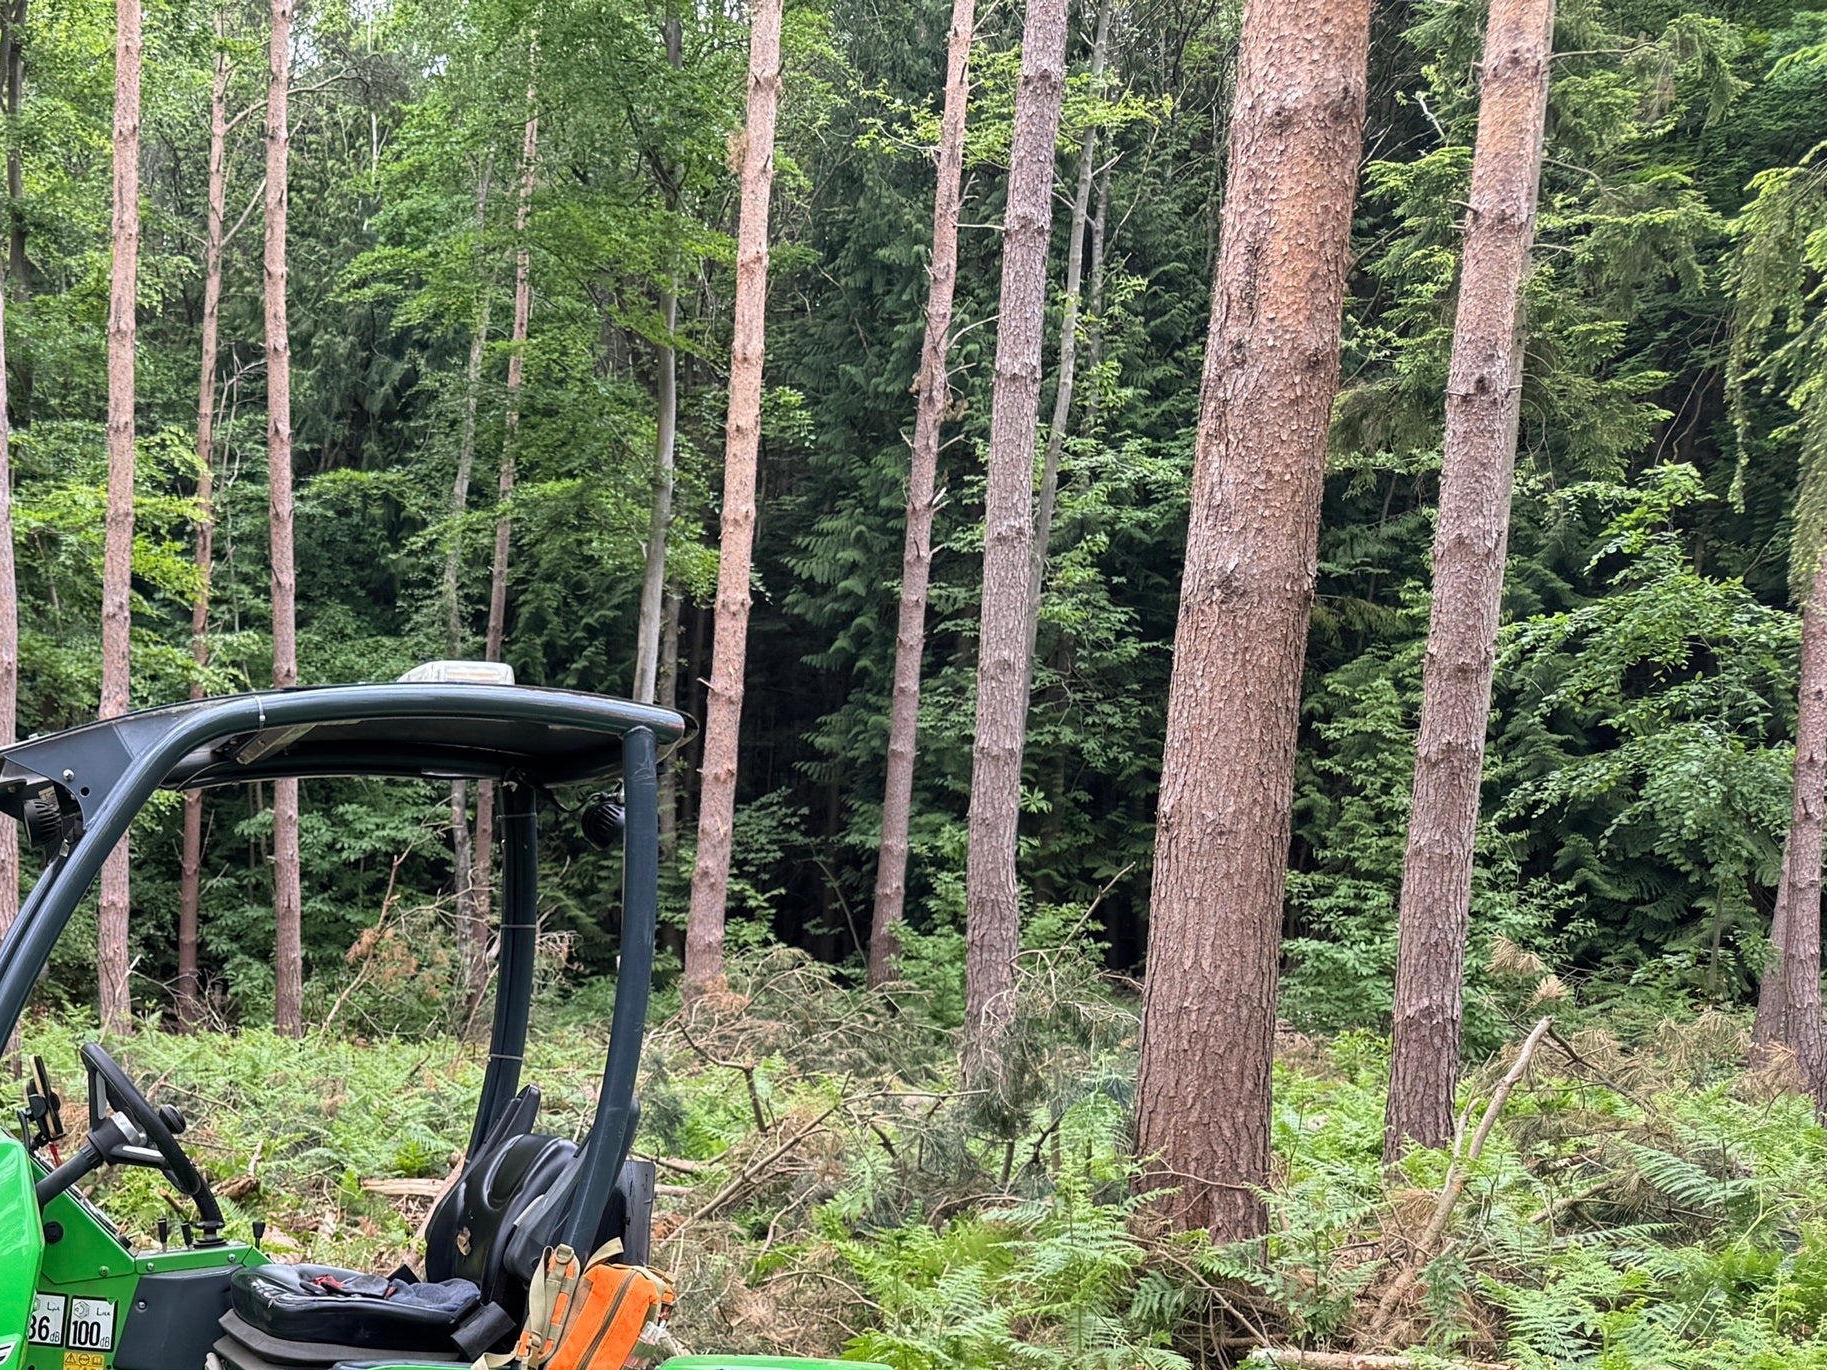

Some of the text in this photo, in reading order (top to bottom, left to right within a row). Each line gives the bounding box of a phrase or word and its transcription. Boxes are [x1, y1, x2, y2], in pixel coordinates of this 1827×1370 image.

[50, 1331, 60, 1342] dB
[72, 1321, 110, 1347] 100 dB
